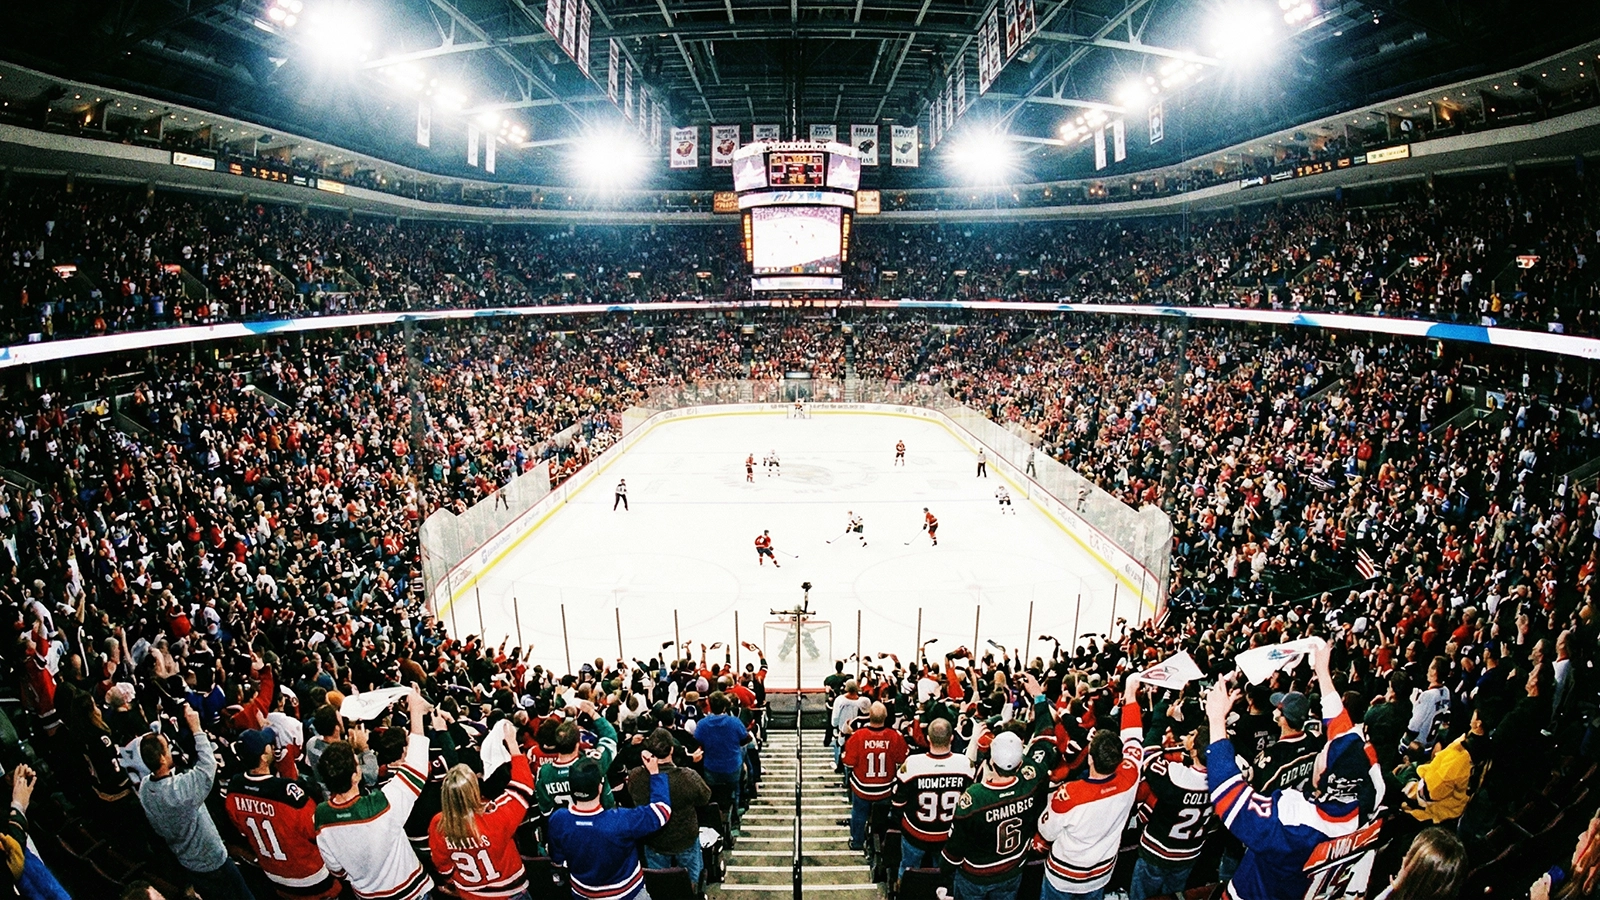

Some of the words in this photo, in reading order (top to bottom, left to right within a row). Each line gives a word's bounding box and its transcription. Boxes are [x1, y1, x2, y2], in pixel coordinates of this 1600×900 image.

[865, 752, 887, 777] 11
[916, 790, 961, 823] 99
[246, 817, 288, 861] 11
[996, 817, 1023, 855] 6
[450, 849, 501, 883] 31
